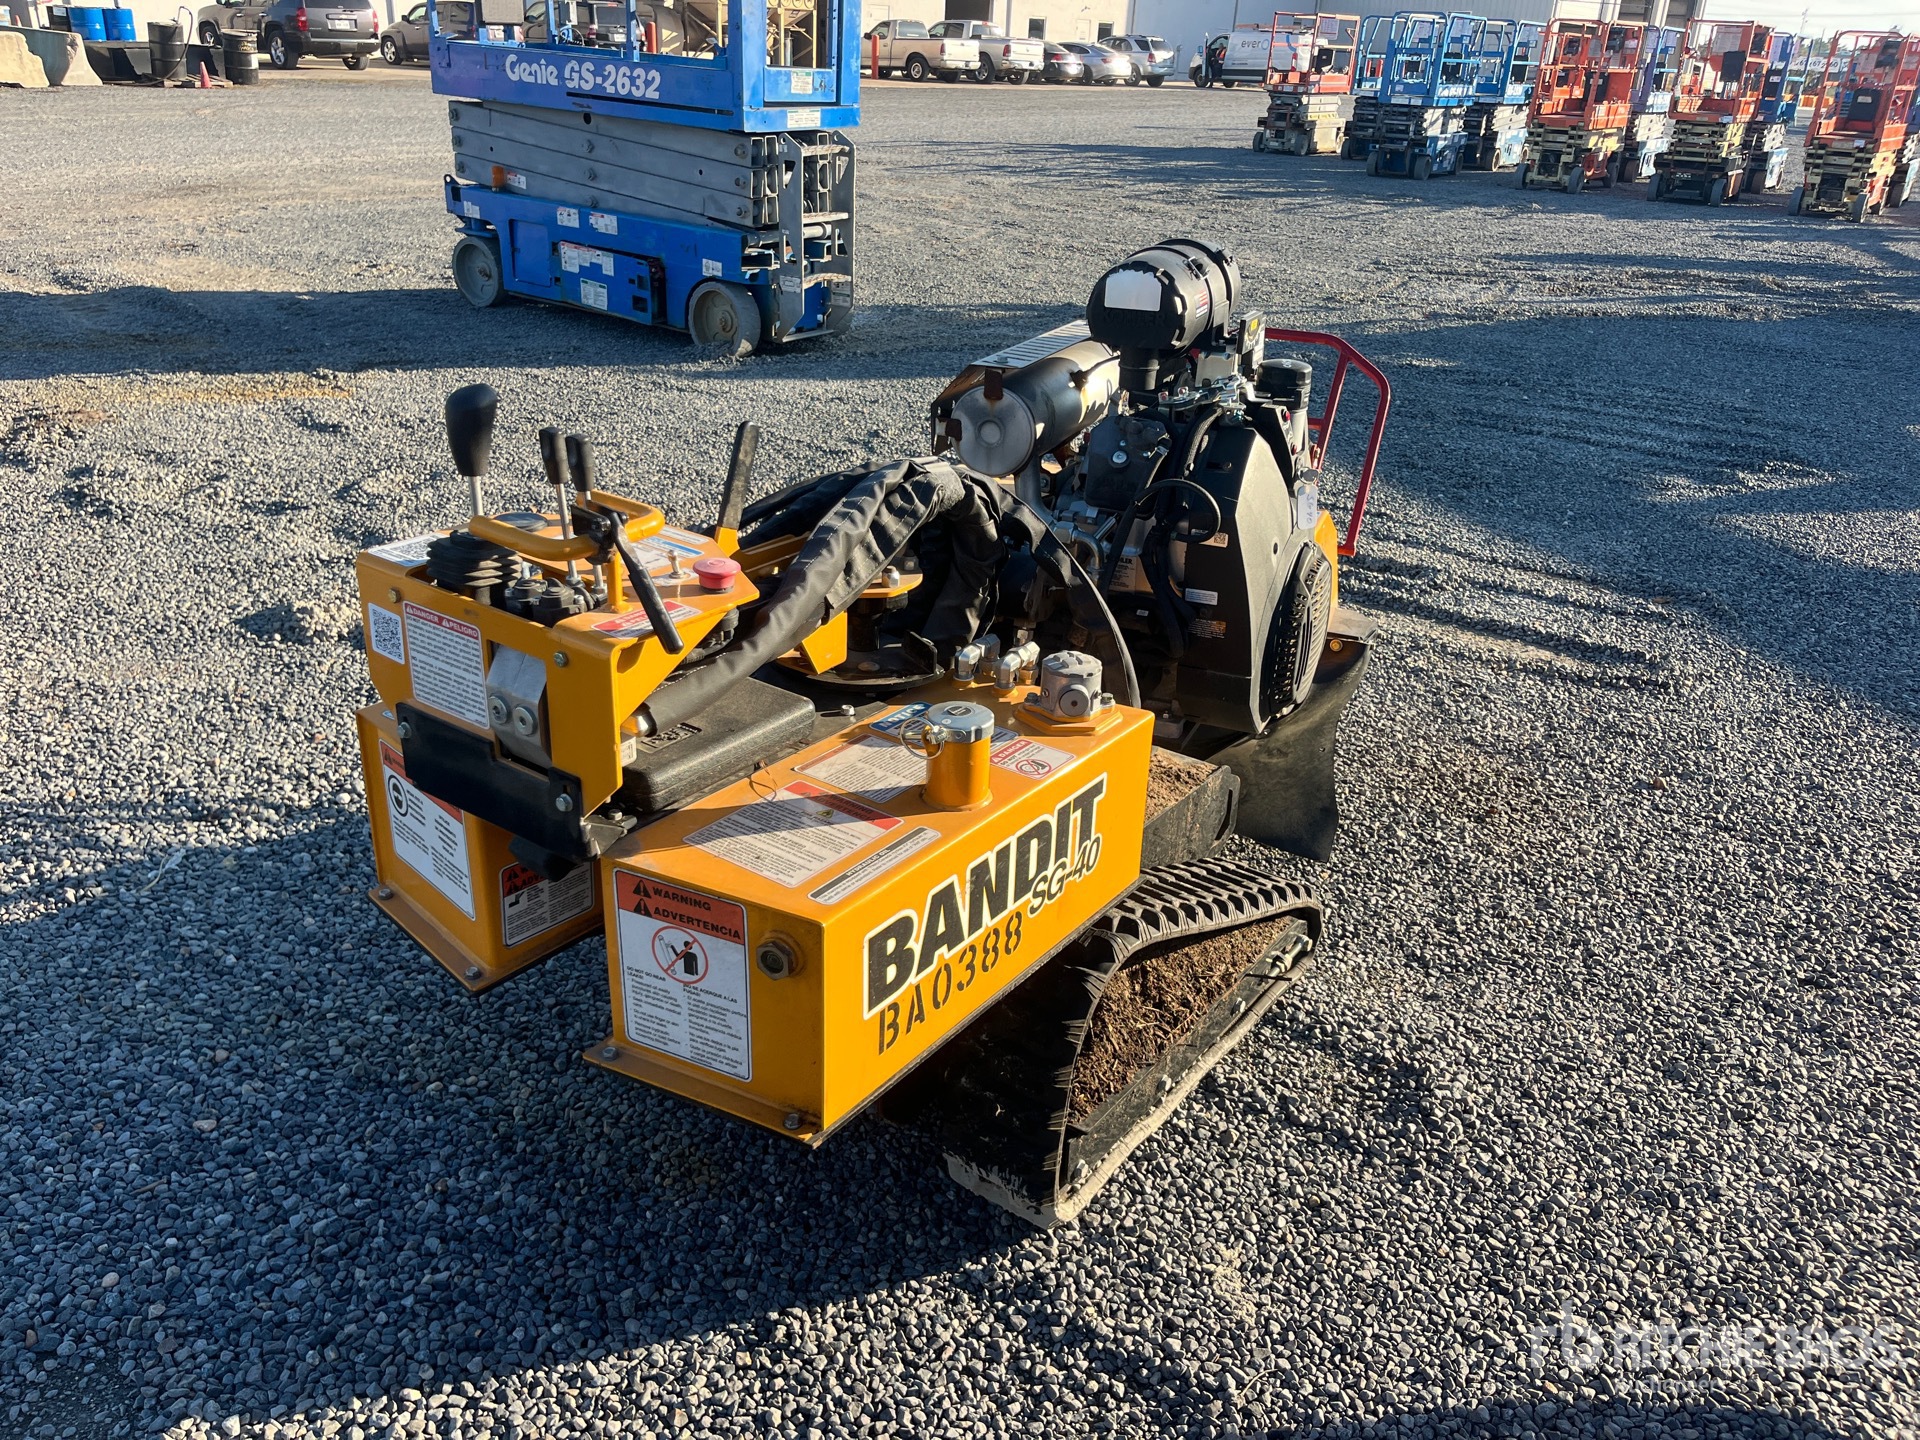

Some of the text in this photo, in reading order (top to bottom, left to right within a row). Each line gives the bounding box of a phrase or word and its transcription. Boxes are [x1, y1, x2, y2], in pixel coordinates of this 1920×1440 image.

[505, 53, 662, 100] Genie GS-2632
[413, 608, 477, 637] DANGER PELIGRO
[879, 704, 927, 728] NOTICE
[997, 740, 1028, 757] DANGER
[844, 848, 891, 876] HYDRAULIC OIL
[1029, 836, 1101, 916] SG-40
[652, 886, 711, 912] WARNING
[864, 774, 1106, 1018] BANDIT
[653, 905, 740, 939] ADVERTENCIA
[878, 910, 1023, 1056] BA0388
